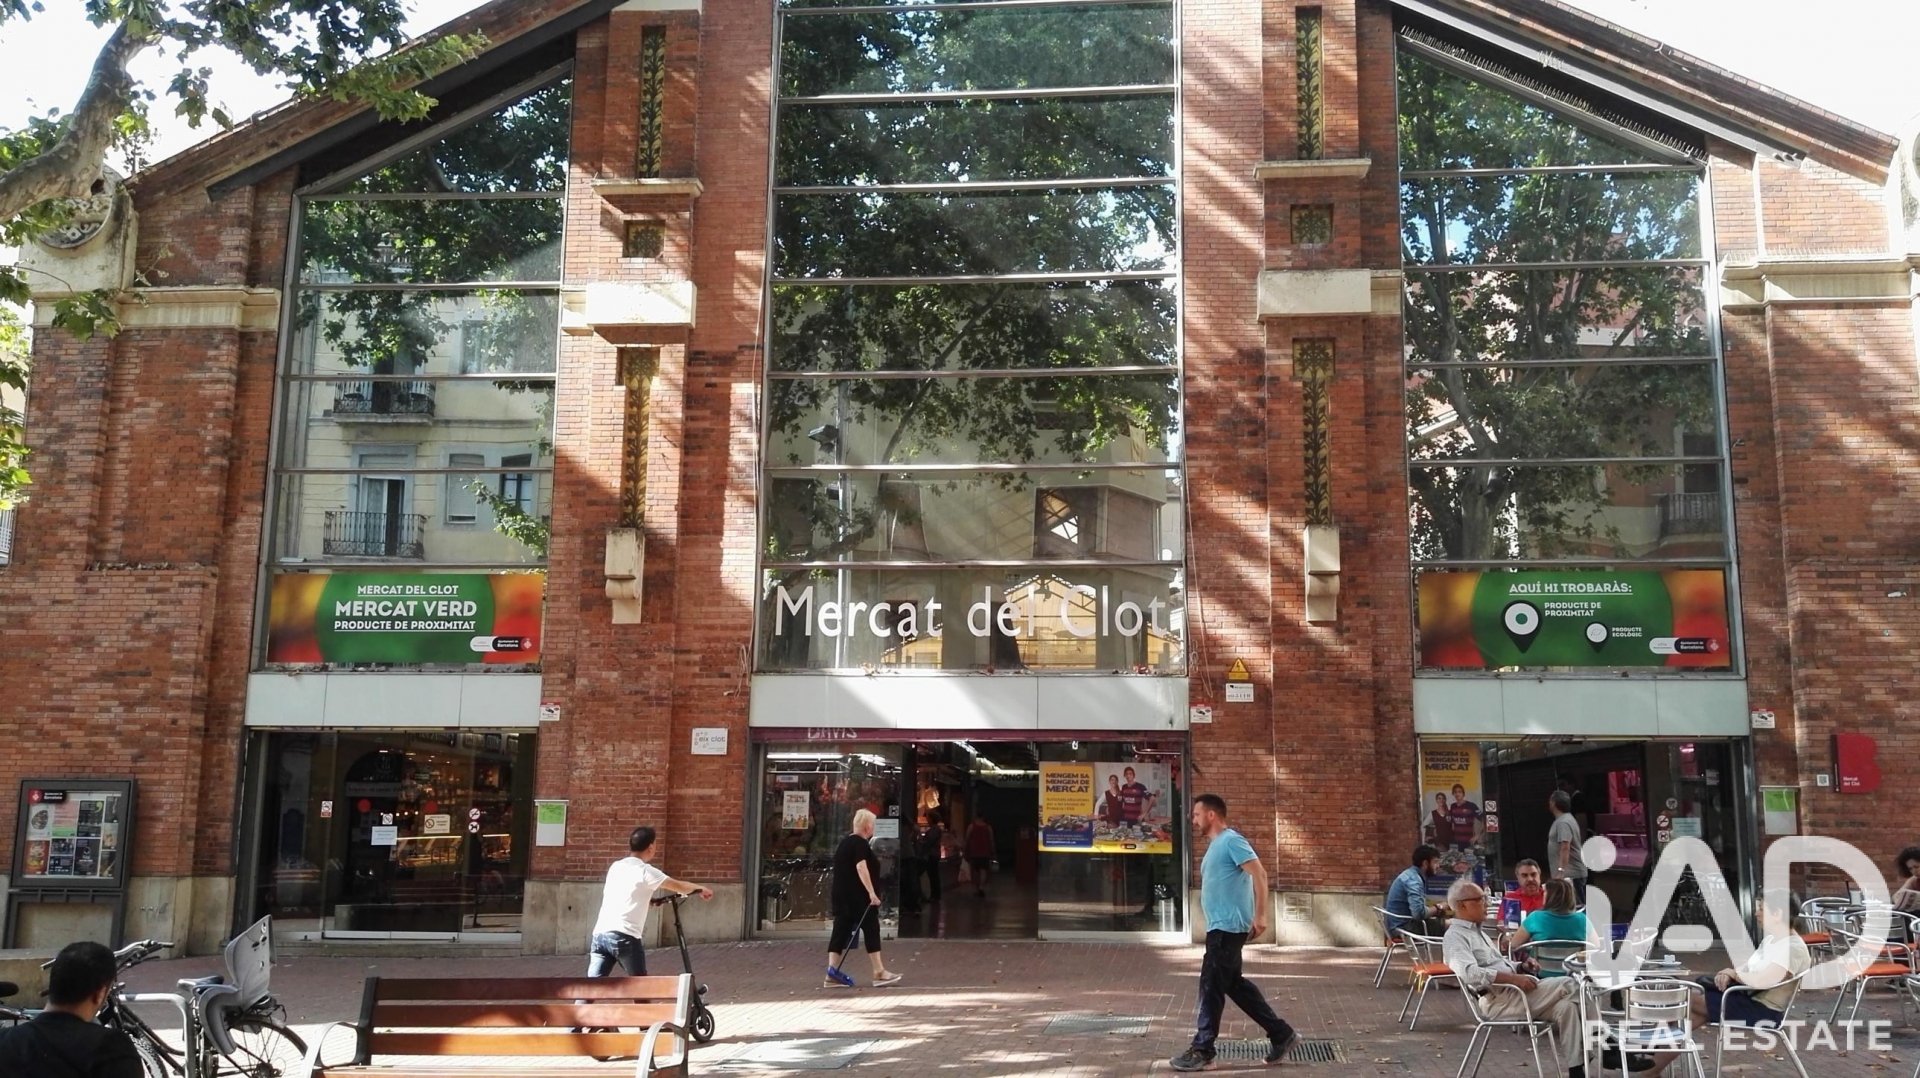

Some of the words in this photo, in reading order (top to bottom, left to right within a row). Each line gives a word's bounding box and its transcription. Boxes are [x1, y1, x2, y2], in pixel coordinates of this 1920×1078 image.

[357, 585, 403, 595] MERCAT
[405, 585, 426, 595] DEL
[428, 585, 459, 594] CLOT
[1509, 581, 1542, 593] AQUÍ
[1544, 583, 1559, 593] HI
[1560, 580, 1633, 593] TROBARÀS:
[335, 600, 418, 617] MERCAT
[422, 600, 477, 617] VERD
[775, 585, 942, 638] Mercat
[967, 585, 1036, 638] del
[1061, 584, 1166, 638] Clot
[334, 621, 392, 630] PRODUCTE
[394, 621, 408, 630] DE
[411, 621, 476, 630] PROXIMITAT
[1425, 763, 1471, 771] MERCAT
[1045, 785, 1089, 793] MERCAT
